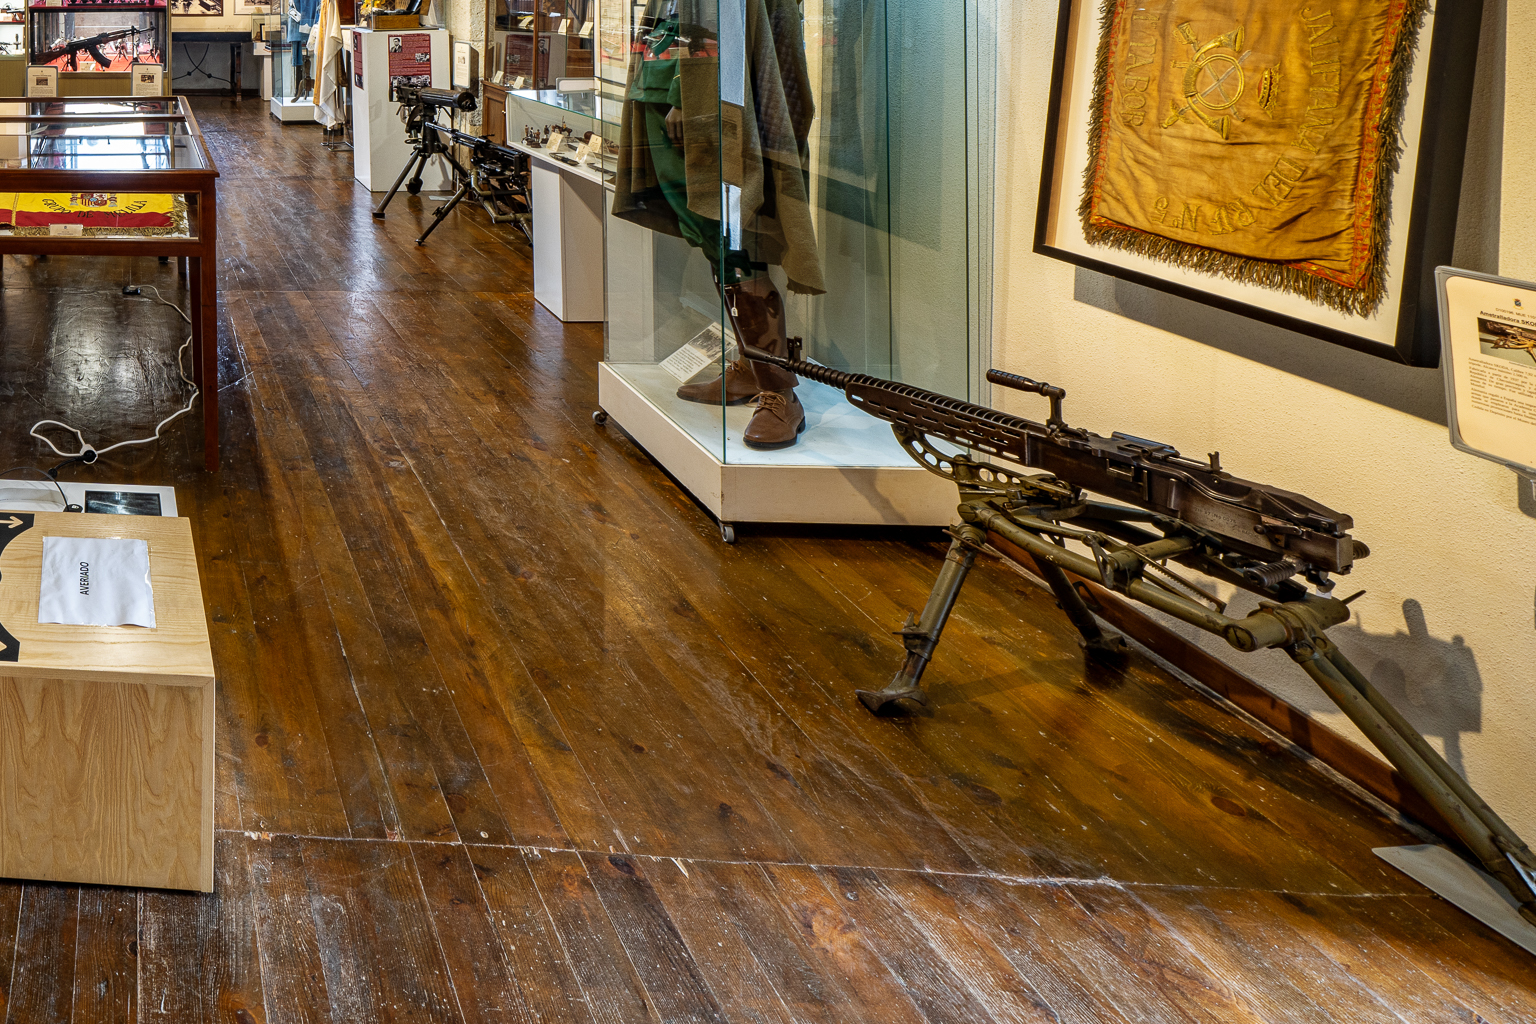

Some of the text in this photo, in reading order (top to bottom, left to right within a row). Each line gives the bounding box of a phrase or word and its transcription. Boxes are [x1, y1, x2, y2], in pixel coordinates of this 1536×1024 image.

[1120, 32, 1158, 127] TABOR
[1249, 153, 1309, 207] DEL
[41, 198, 148, 219] GRUPO DE MELILLA
[1479, 310, 1520, 324] Ametralladora
[79, 561, 90, 596] AVERIADO
